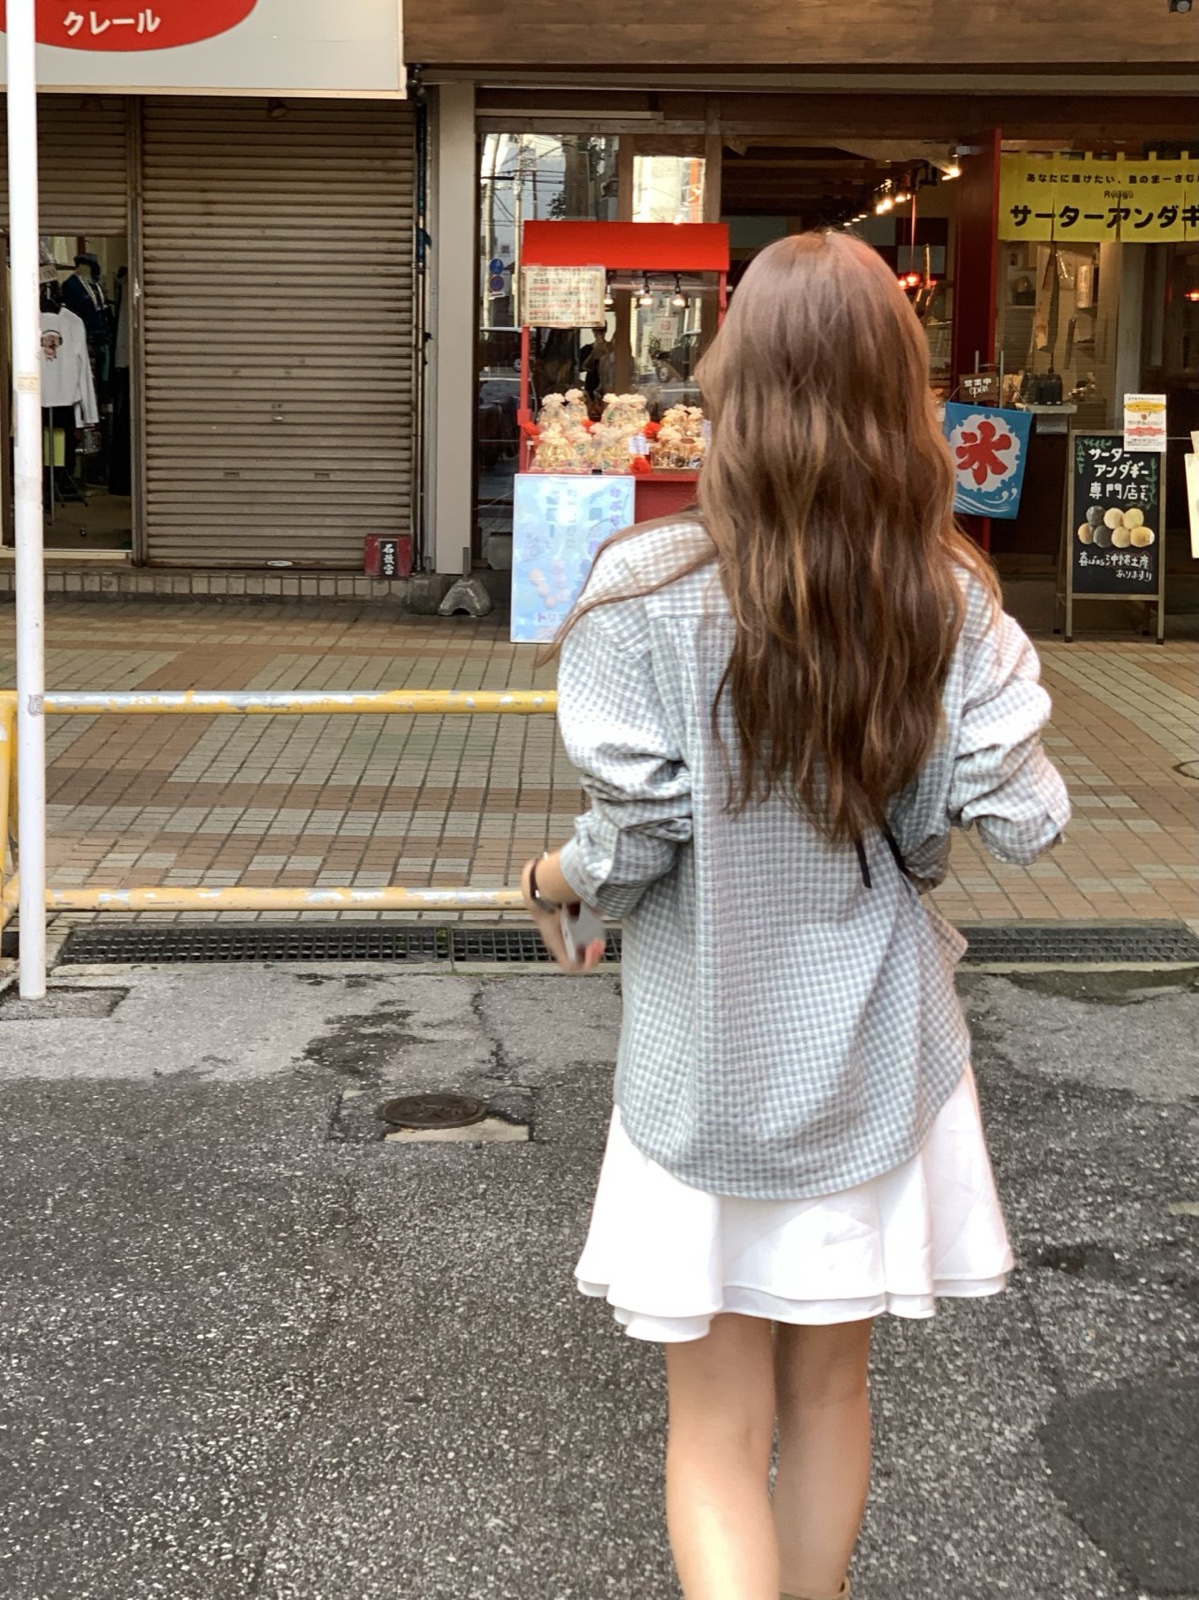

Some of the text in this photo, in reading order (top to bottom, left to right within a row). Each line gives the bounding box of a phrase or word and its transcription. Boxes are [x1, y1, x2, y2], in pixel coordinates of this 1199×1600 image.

[62, 8, 162, 37] クレール
[955, 420, 1012, 486] 氷
[1088, 448, 1131, 463] サーター
[1094, 460, 1149, 480] アンダギー
